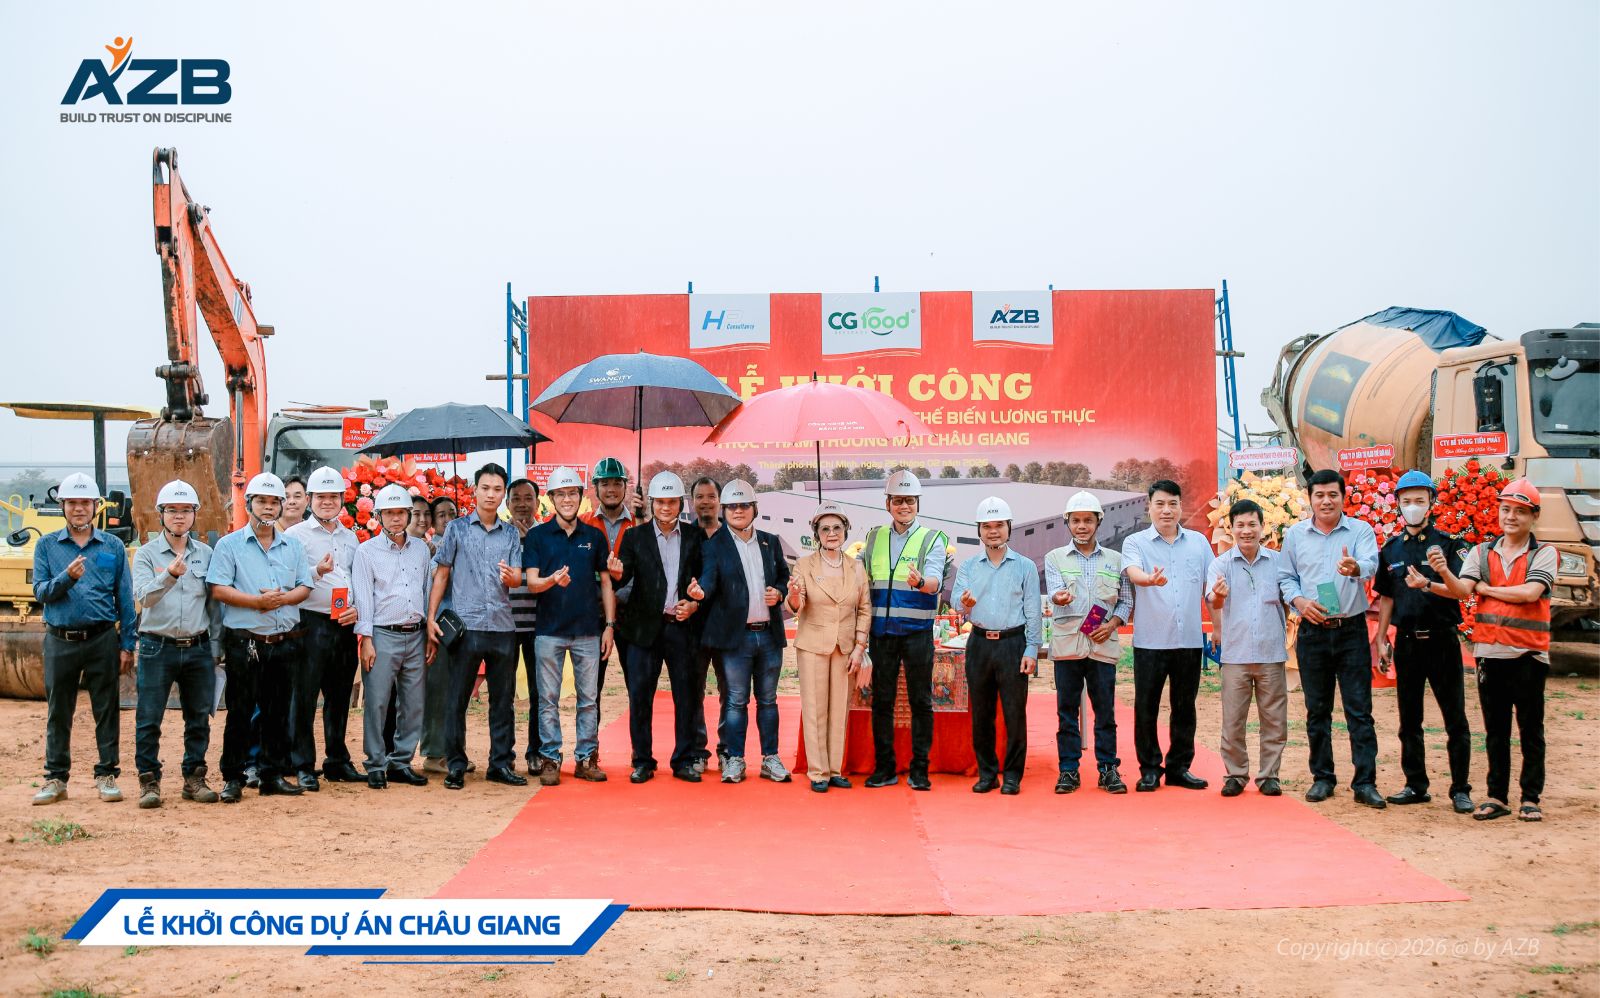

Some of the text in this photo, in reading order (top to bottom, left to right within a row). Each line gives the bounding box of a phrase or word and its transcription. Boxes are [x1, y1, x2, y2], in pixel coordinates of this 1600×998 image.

[828, 311, 858, 330] CG
[861, 307, 909, 330] food
[990, 307, 1040, 324] AZB
[588, 375, 632, 383] SWANCITY
[717, 364, 765, 402] Ễ
[908, 368, 1033, 401] CÔNG
[913, 406, 1096, 426] HẾ BIẾN LƯƠNG THỰC
[927, 430, 973, 446] CHÂU
[977, 432, 1030, 446] GIANG
